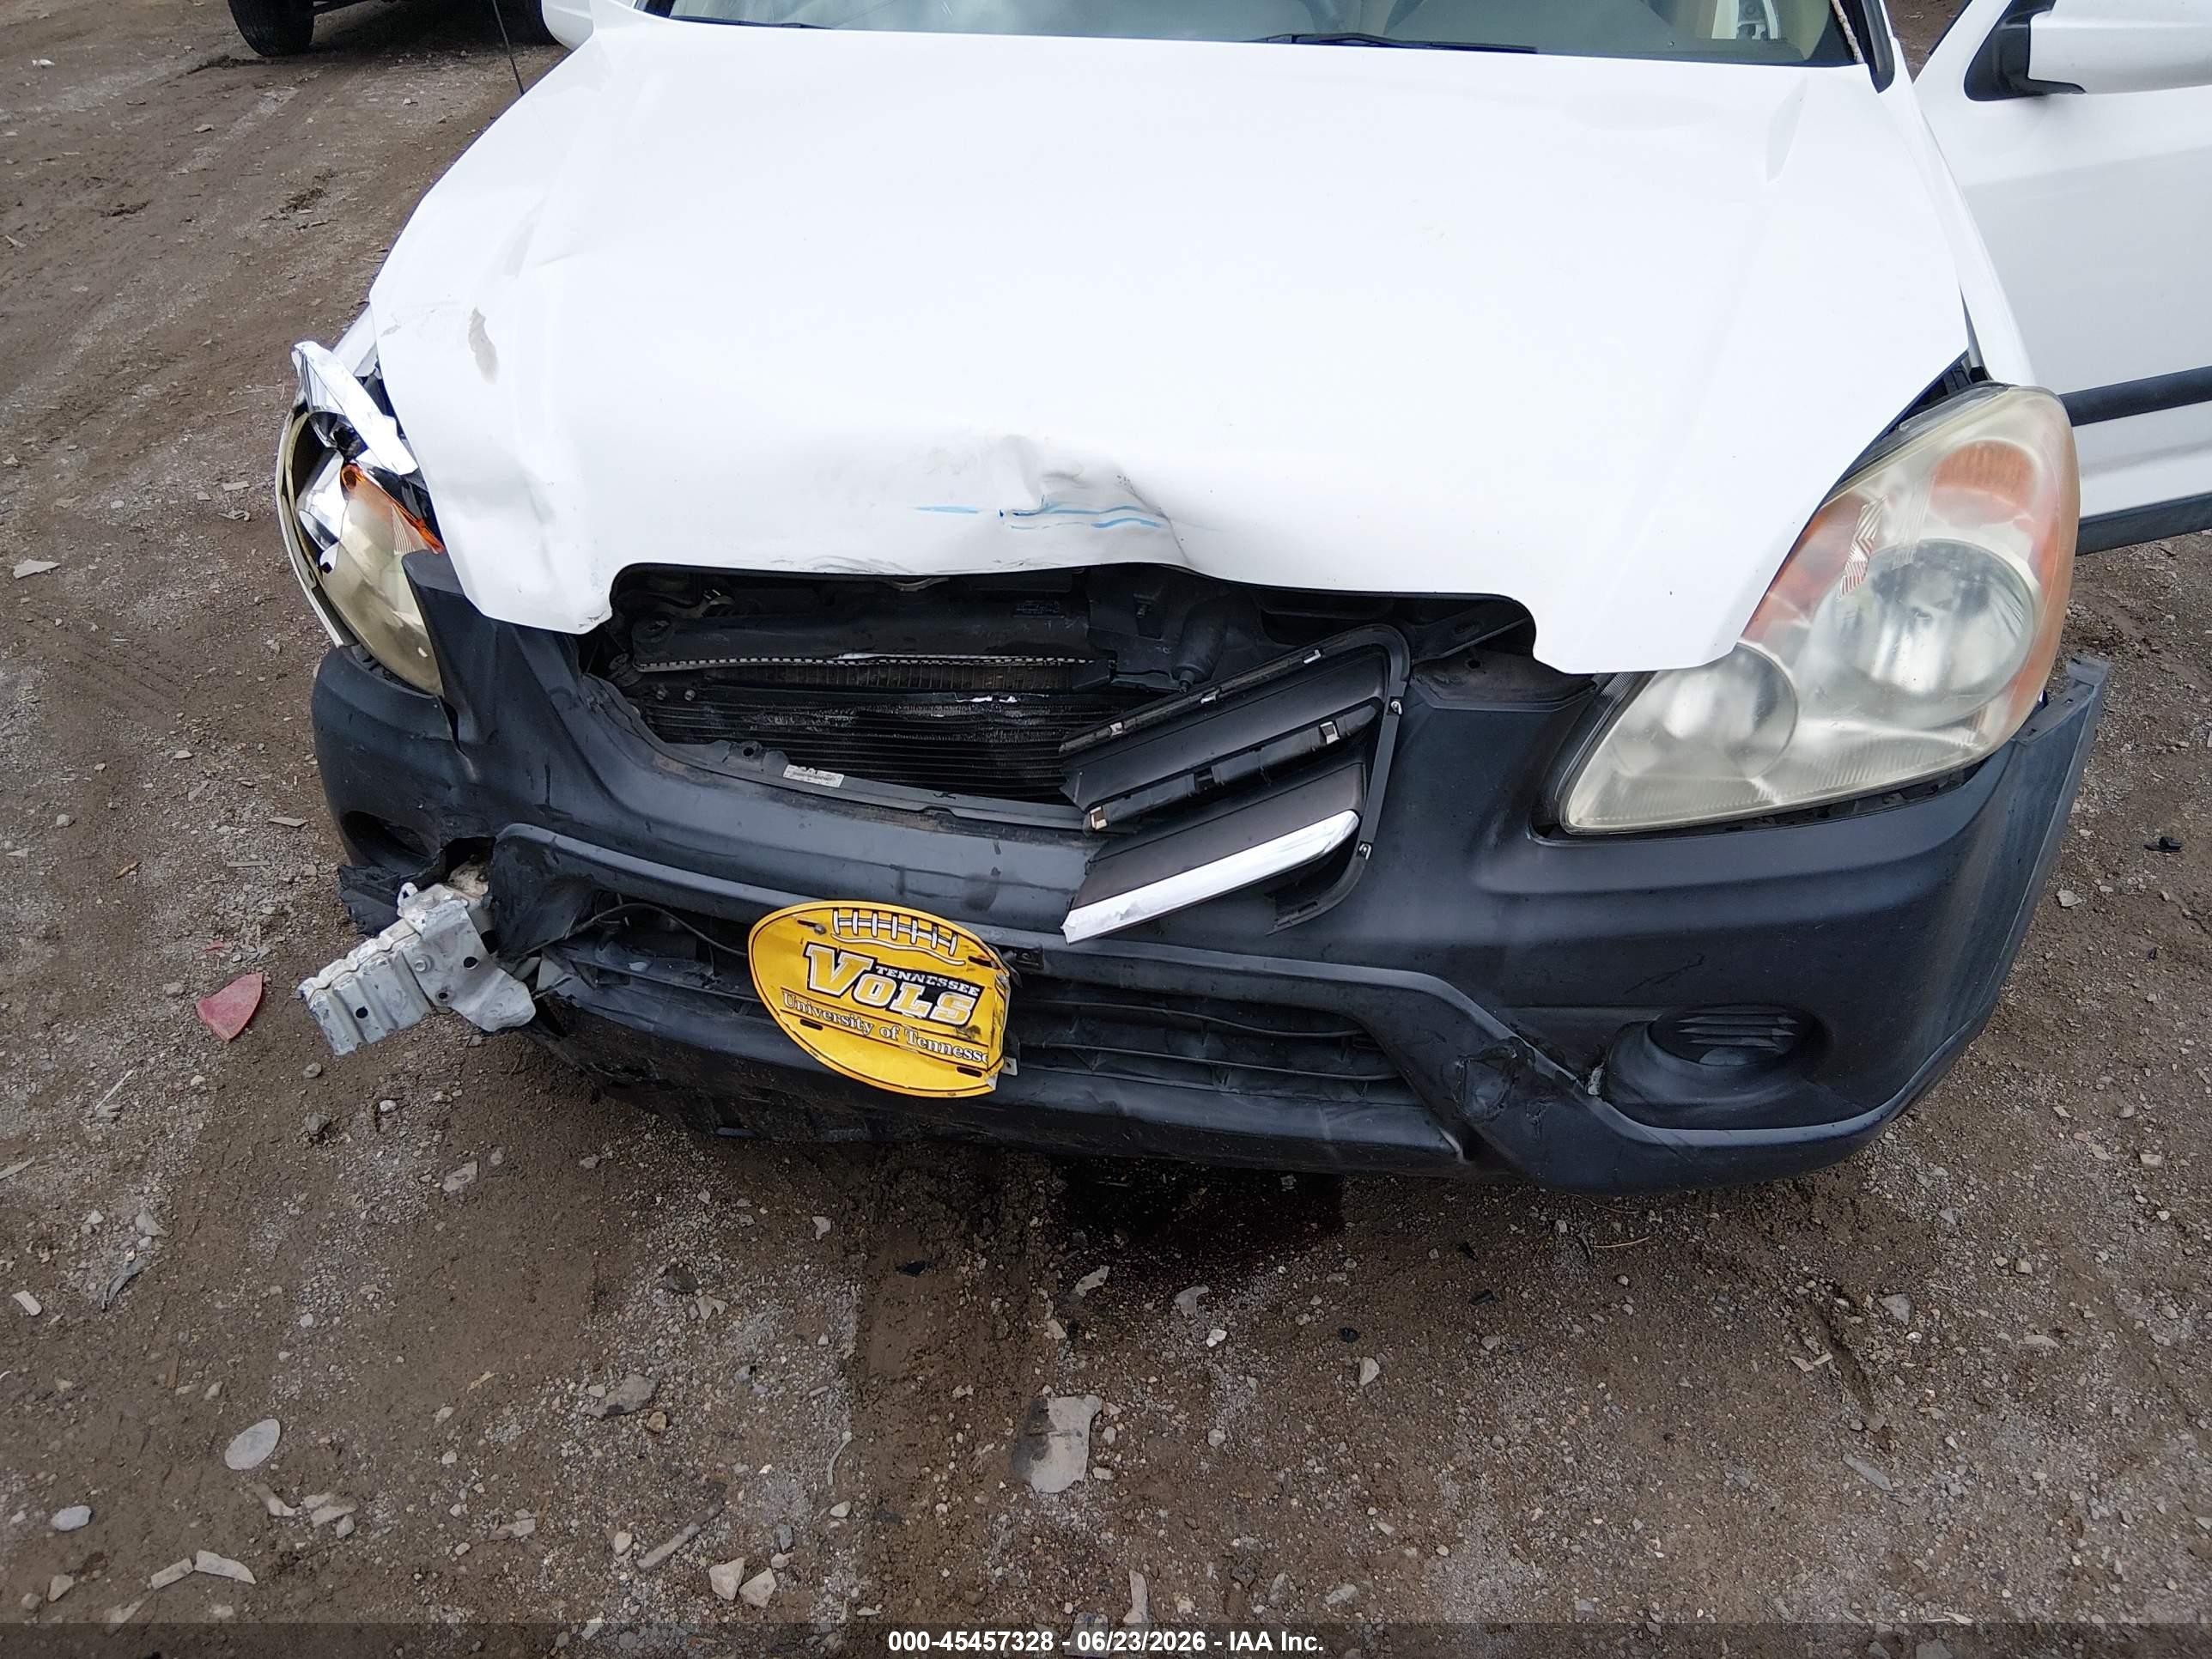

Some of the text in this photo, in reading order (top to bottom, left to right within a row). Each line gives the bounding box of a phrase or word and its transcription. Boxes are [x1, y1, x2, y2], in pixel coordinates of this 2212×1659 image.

[876, 965, 980, 996] TENNESSEE
[783, 993, 874, 1036] University
[879, 1025, 900, 1041] of
